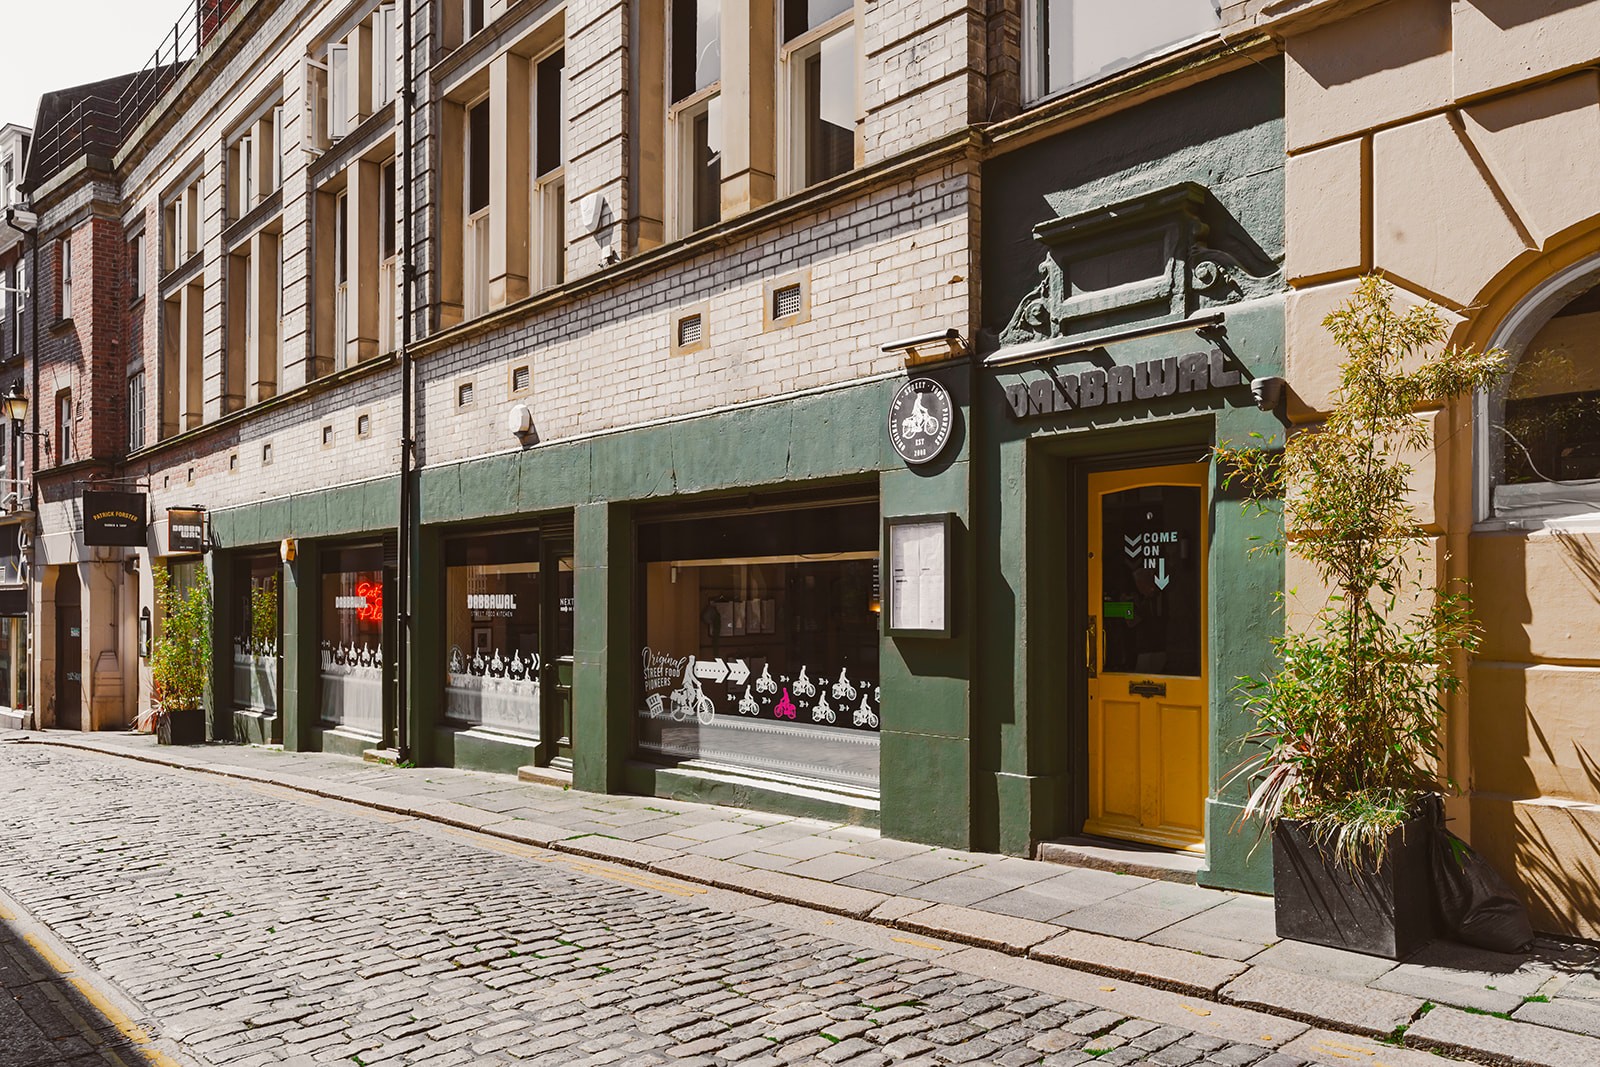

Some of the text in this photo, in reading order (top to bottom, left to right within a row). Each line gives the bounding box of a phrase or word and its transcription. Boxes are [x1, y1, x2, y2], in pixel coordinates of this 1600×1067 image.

[1005, 349, 1240, 417] DABBAWAL
[891, 381, 949, 452] ORIGINAL UK STREET FOOD PIONEERS
[915, 438, 925, 447] EST
[913, 448, 927, 457] 2008
[93, 511, 139, 522] PATRICK FORSTER
[172, 524, 201, 532] DABBA
[181, 531, 201, 539] WAL
[1143, 531, 1178, 544] COME
[1143, 545, 1160, 557] ON
[1143, 558, 1156, 569] IN
[335, 596, 369, 608] DABBAWAL
[467, 594, 516, 609] DABBAWAL
[496, 610, 513, 618] KITCHEN
[642, 646, 687, 672] Original
[643, 667, 681, 679] STREET FOOD
[645, 677, 671, 691] PIONEERS
[649, 696, 658, 705] EST
